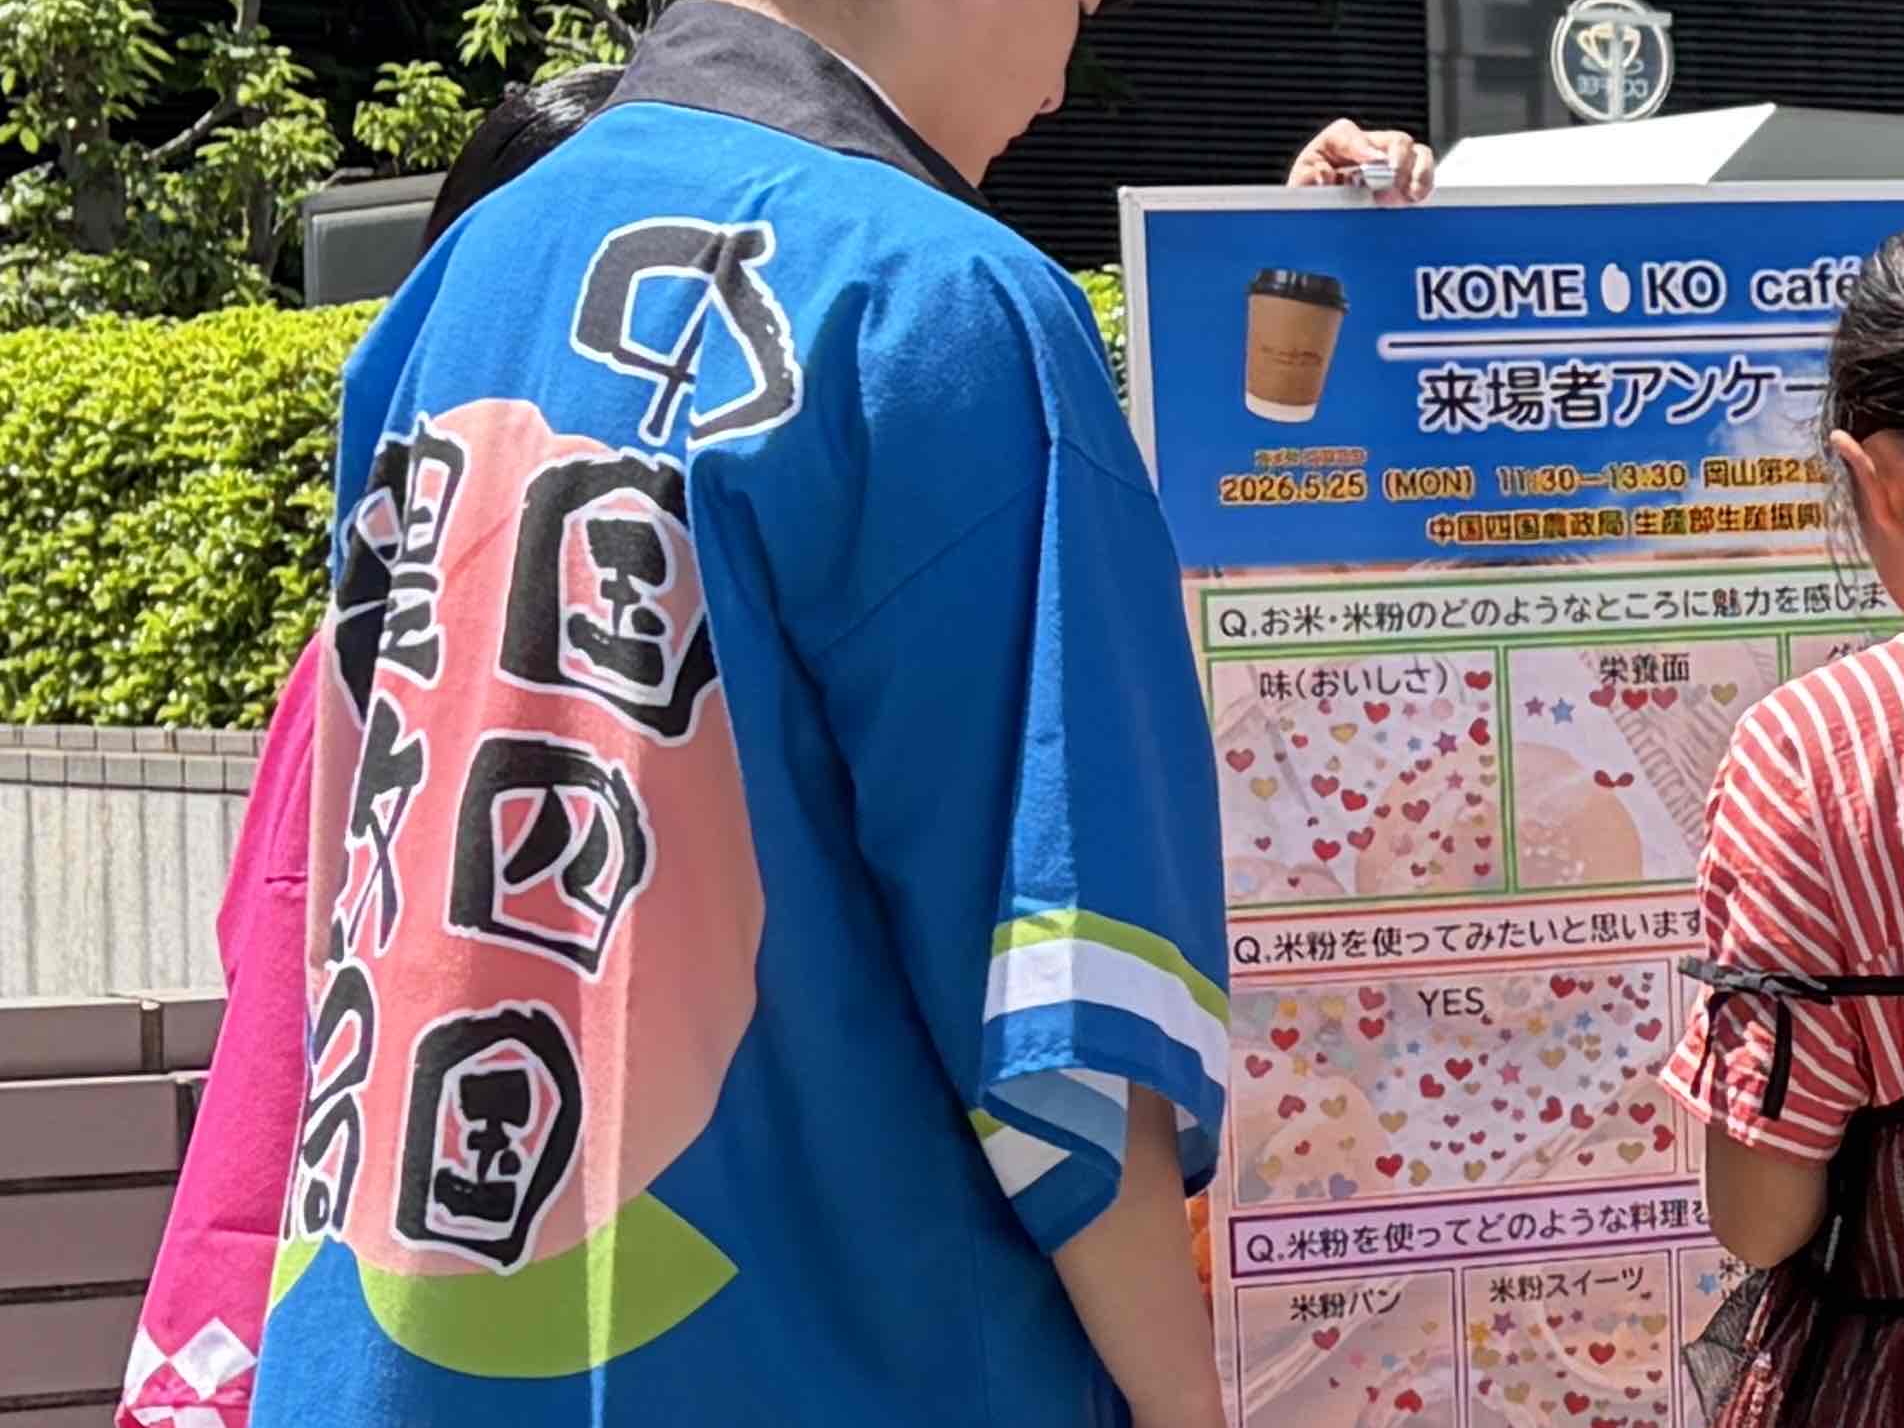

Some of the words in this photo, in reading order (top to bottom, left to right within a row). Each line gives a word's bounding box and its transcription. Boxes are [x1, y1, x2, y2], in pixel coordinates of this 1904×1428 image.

[1419, 264, 1586, 317] KOME
[1646, 261, 1725, 312] KO
[1421, 358, 1829, 430] 来場者アンケー
[1220, 470, 1367, 504] 2026.5.25
[1383, 466, 1474, 502] (MON)
[1599, 652, 1690, 685] 栄養面
[1418, 988, 1485, 1018] YES
[1488, 1265, 1645, 1304] 米粉スイーツ
[1290, 1288, 1401, 1322] 米粉パン
